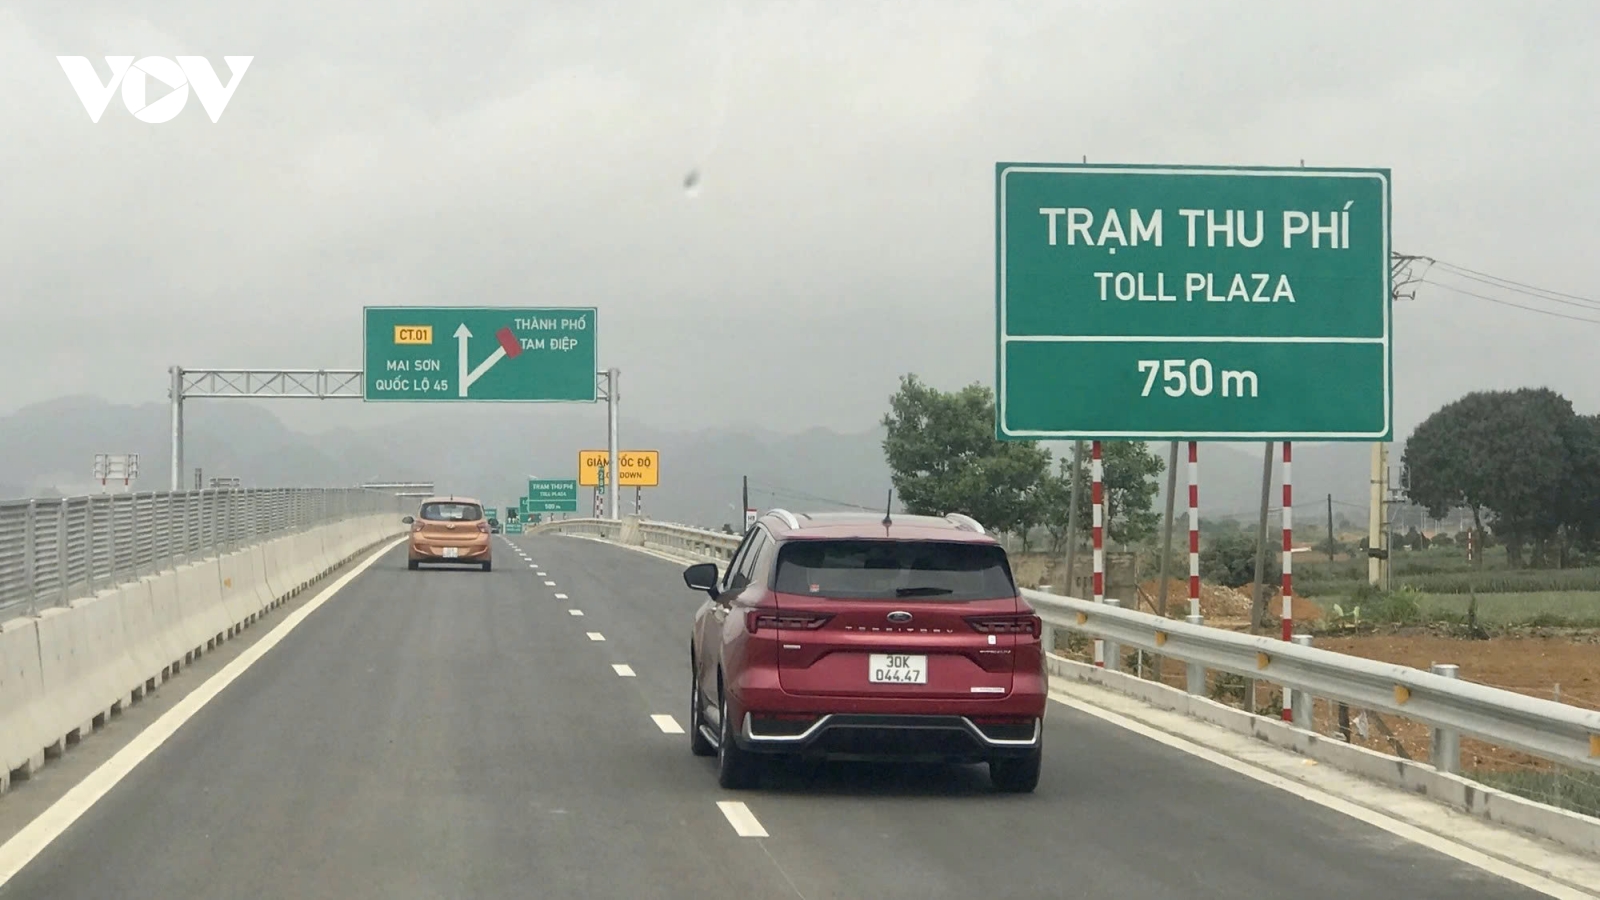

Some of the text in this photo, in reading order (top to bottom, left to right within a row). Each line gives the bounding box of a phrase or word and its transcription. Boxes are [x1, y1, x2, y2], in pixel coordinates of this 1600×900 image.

[1039, 200, 1355, 254] TRẠM THU PHÍ
[1093, 272, 1296, 302] TOLL PLAZA
[514, 314, 586, 330] THÀNH PHỐ
[399, 329, 428, 341] CT.01
[520, 336, 578, 352] TAM ĐIỆP
[386, 359, 441, 371] MAI SƠN
[376, 375, 448, 392] QUỐC LỘ 45
[1137, 358, 1258, 398] 750 m
[886, 655, 910, 668] 30K
[876, 669, 920, 682] 044.47
